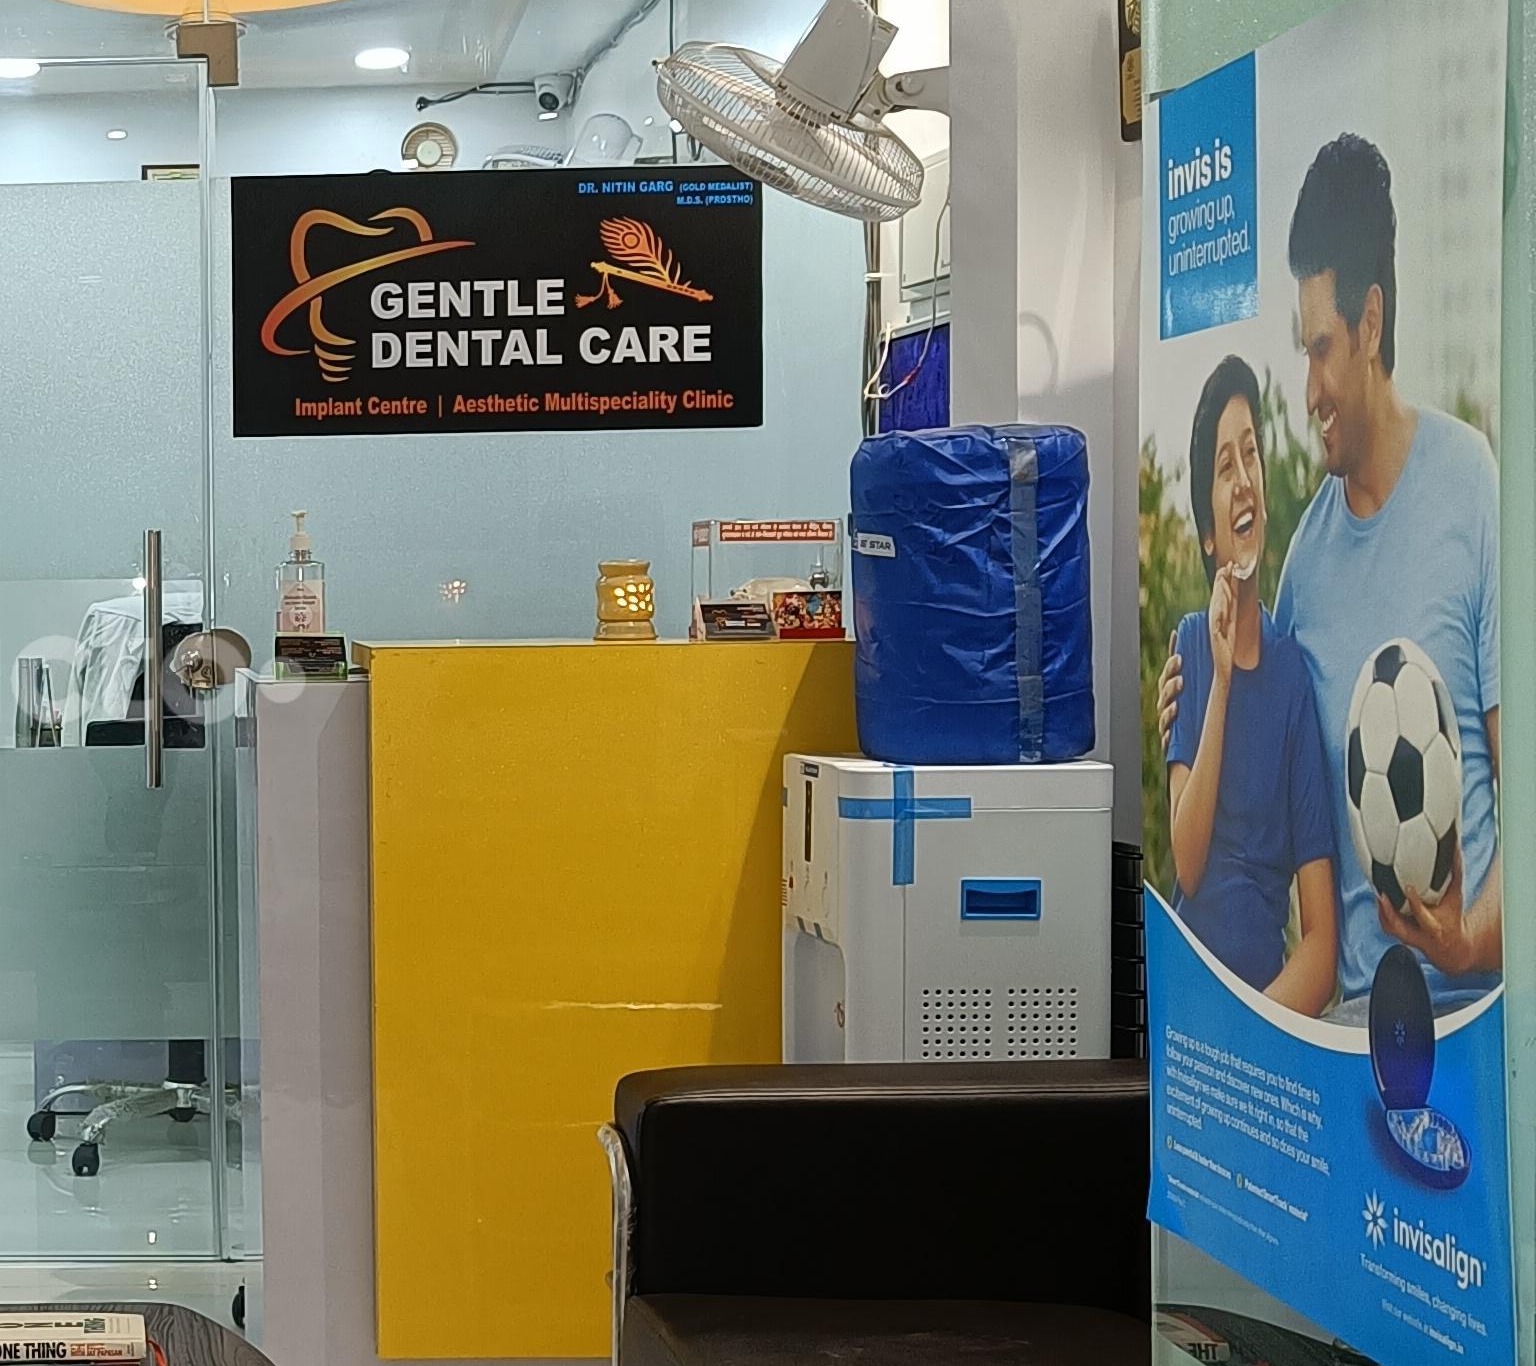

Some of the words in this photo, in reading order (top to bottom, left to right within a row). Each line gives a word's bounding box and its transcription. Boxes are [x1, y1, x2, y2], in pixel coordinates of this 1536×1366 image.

[578, 182, 599, 194] DR.
[602, 181, 636, 193] NITIN
[639, 181, 673, 192] GARG
[679, 182, 706, 192] (GOLD
[707, 181, 754, 191] MEDALIST)
[1168, 146, 1212, 200] invis
[1214, 138, 1232, 181] is
[705, 194, 754, 206] (PROSTHO)
[1168, 198, 1215, 245] growing
[1216, 194, 1235, 225] up,
[1169, 220, 1251, 276] uninterrupted.
[370, 278, 565, 321] GENTLE
[371, 329, 563, 369] DENTAL
[578, 325, 713, 365] CARE
[295, 396, 363, 421] Implant
[367, 395, 427, 416] Centre
[452, 392, 539, 414] Aesthetic
[544, 391, 677, 416] Multispeciality
[682, 389, 735, 411] Clinic
[1393, 1207, 1482, 1290] invisalign
[24, 1342, 67, 1359] THING
